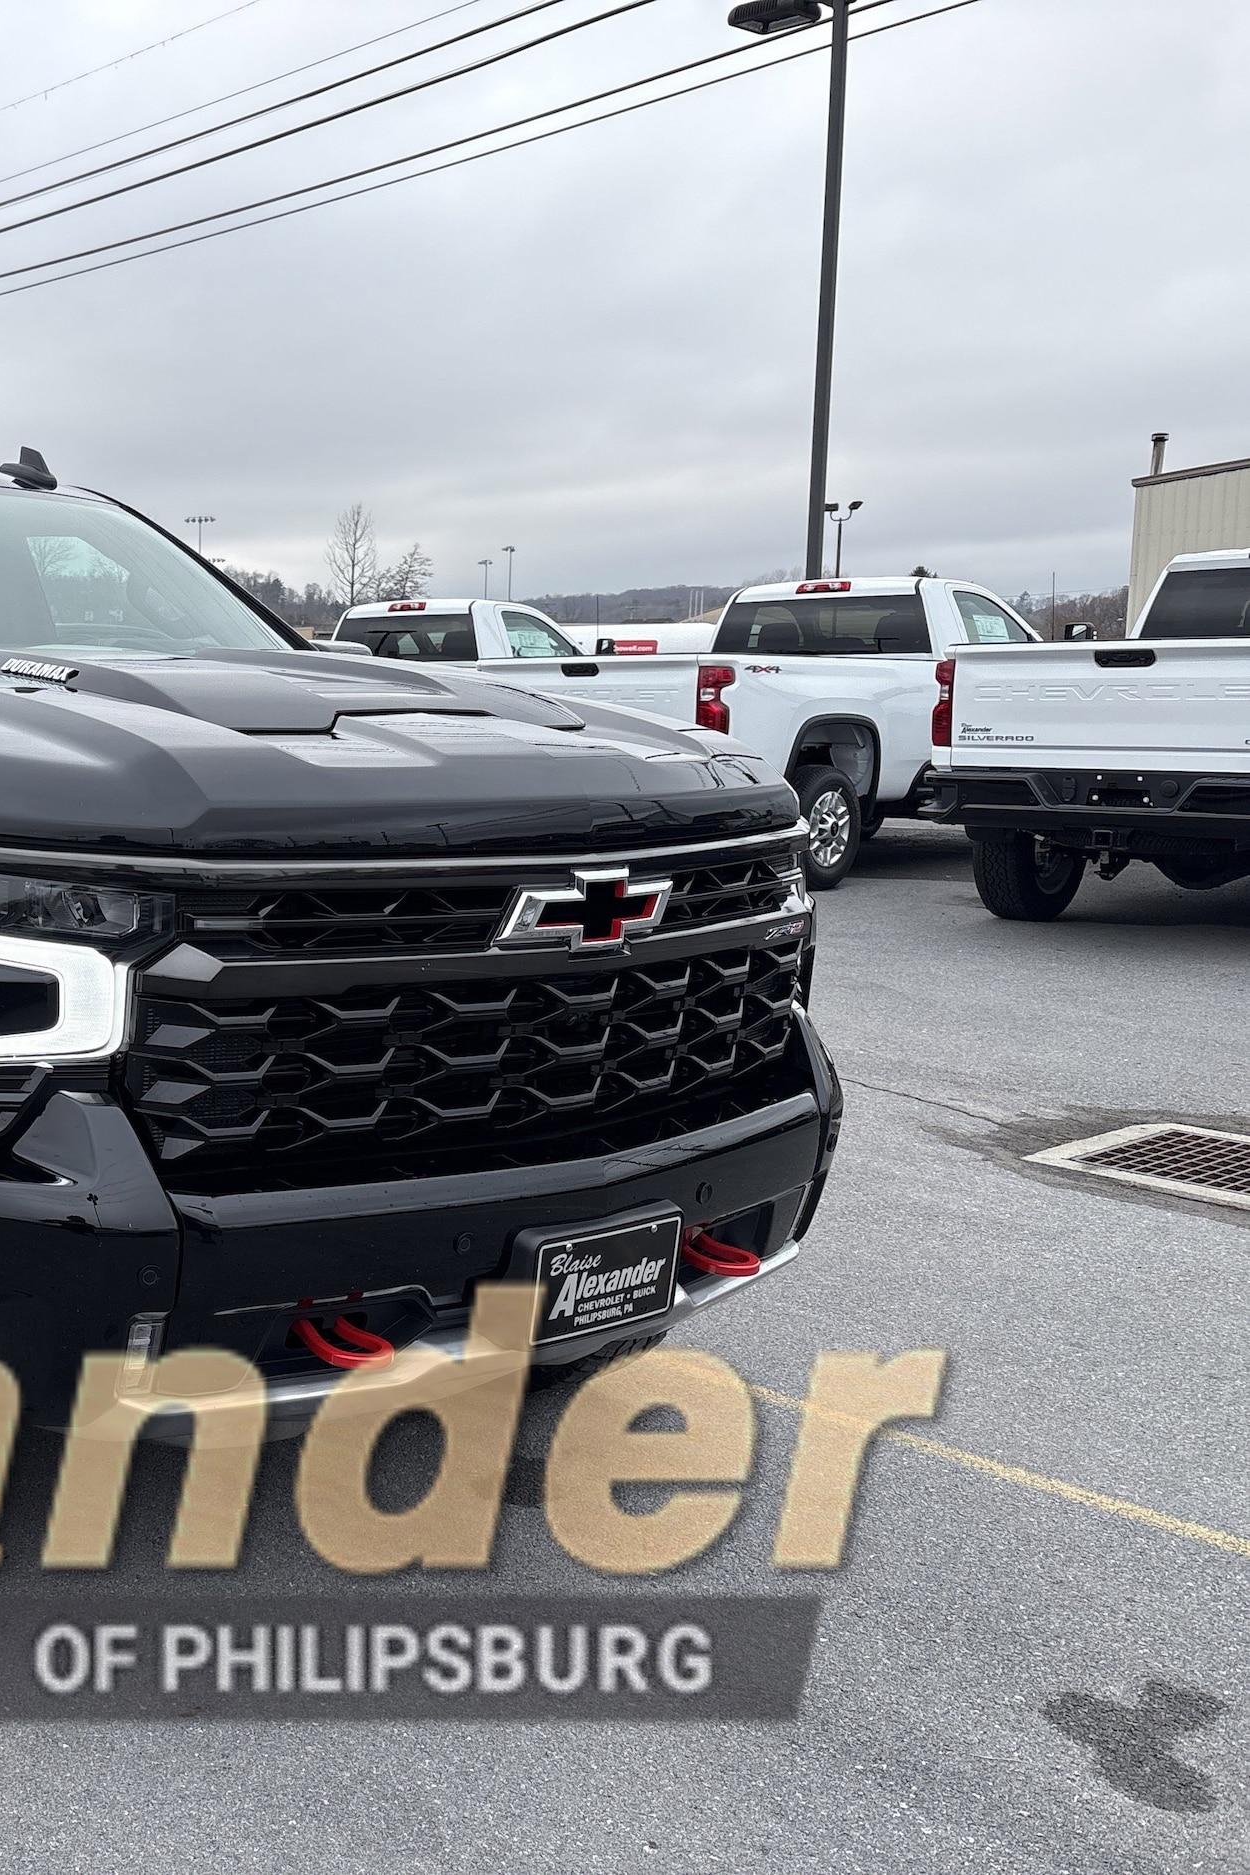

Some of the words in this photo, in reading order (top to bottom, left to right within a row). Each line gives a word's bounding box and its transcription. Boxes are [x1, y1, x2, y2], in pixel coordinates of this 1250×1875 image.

[0, 658, 76, 681] DURAMAX
[974, 684, 1250, 702] CHEVROLE
[549, 1252, 602, 1277] Blaise
[548, 1257, 667, 1321] Alexander
[577, 1293, 626, 1313] CHEVROLET
[632, 1285, 657, 1300] BUICK
[573, 1305, 623, 1327] PHILIPSBURG,
[623, 1302, 634, 1314] PA
